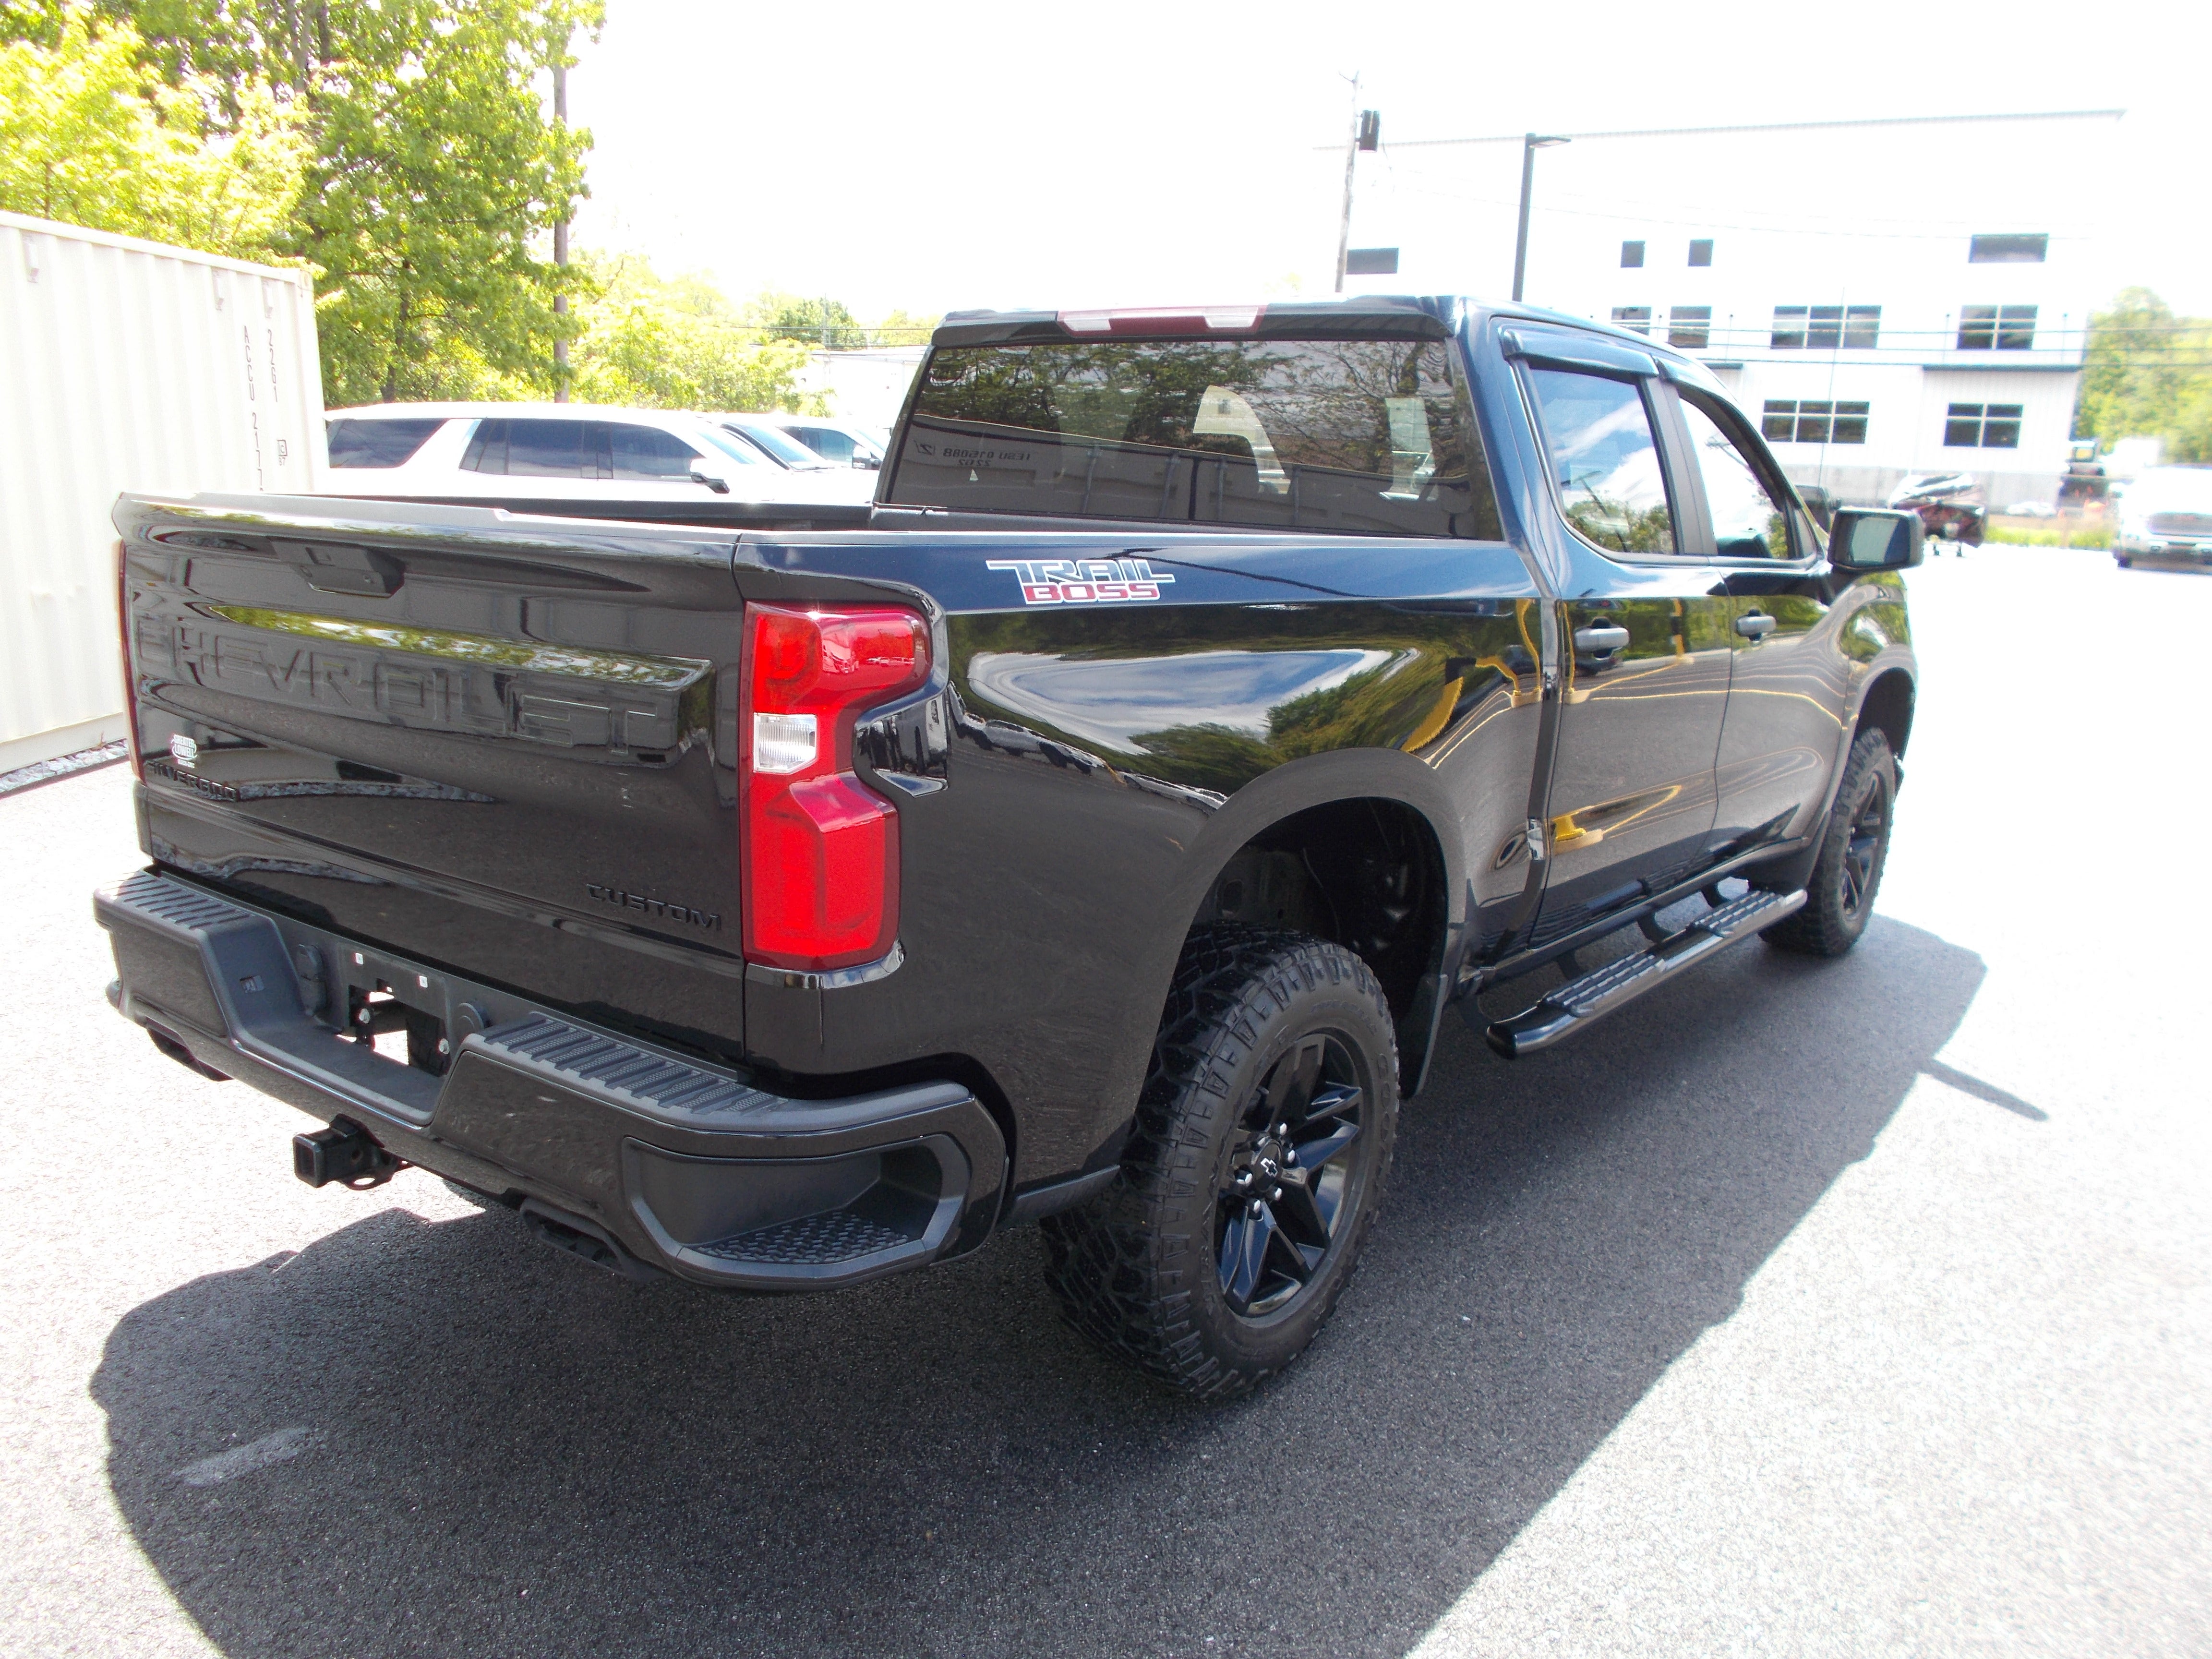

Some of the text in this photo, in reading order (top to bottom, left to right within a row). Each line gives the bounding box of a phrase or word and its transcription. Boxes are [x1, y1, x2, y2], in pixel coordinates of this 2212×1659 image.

[244, 325, 255, 401] ACCU
[267, 328, 278, 403] 22G1
[986, 559, 1176, 584] TRAIL
[1022, 582, 1160, 604] BOSS
[137, 618, 657, 755] CHEVROLET
[586, 884, 721, 931] CUSTOM
